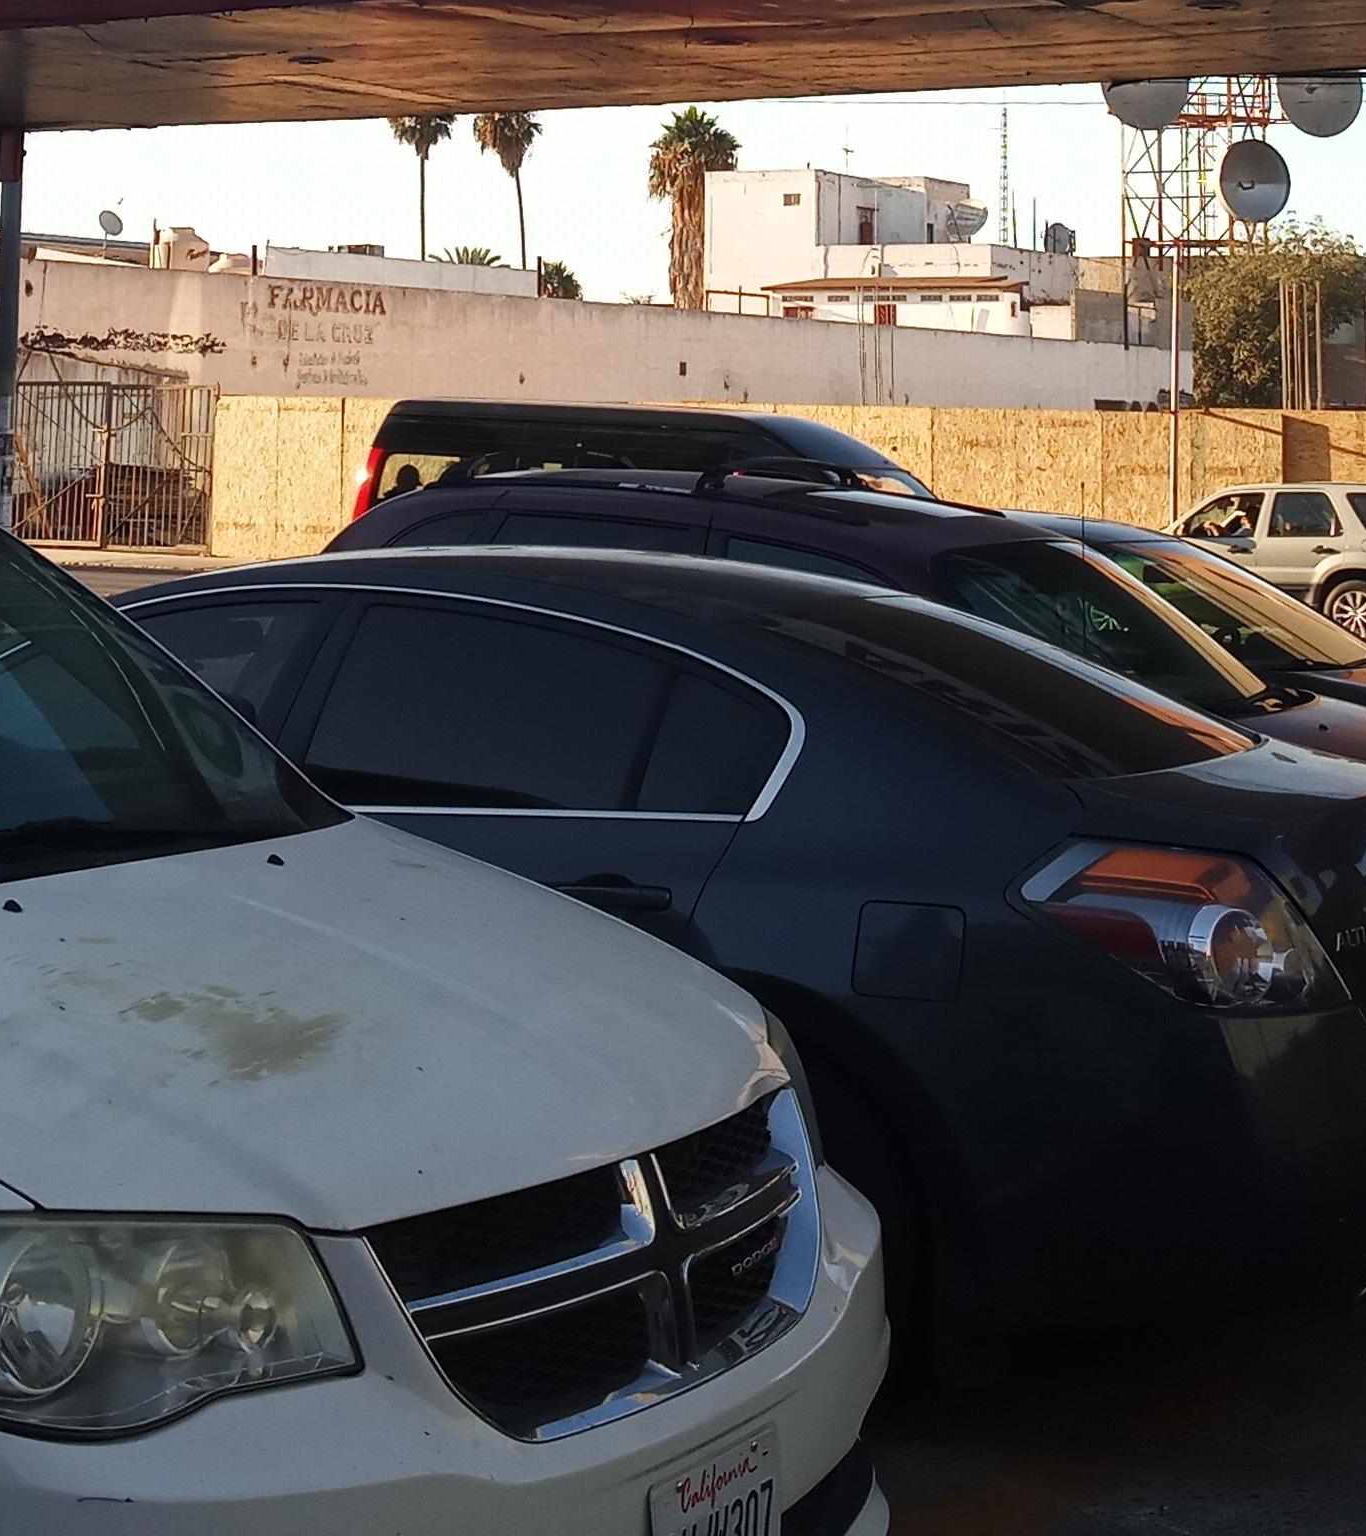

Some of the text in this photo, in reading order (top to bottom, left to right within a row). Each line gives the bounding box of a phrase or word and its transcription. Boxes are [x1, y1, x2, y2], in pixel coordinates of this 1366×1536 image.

[267, 284, 387, 316] FARMACIA
[731, 1238, 779, 1276] DODGE
[678, 1457, 758, 1512] California
